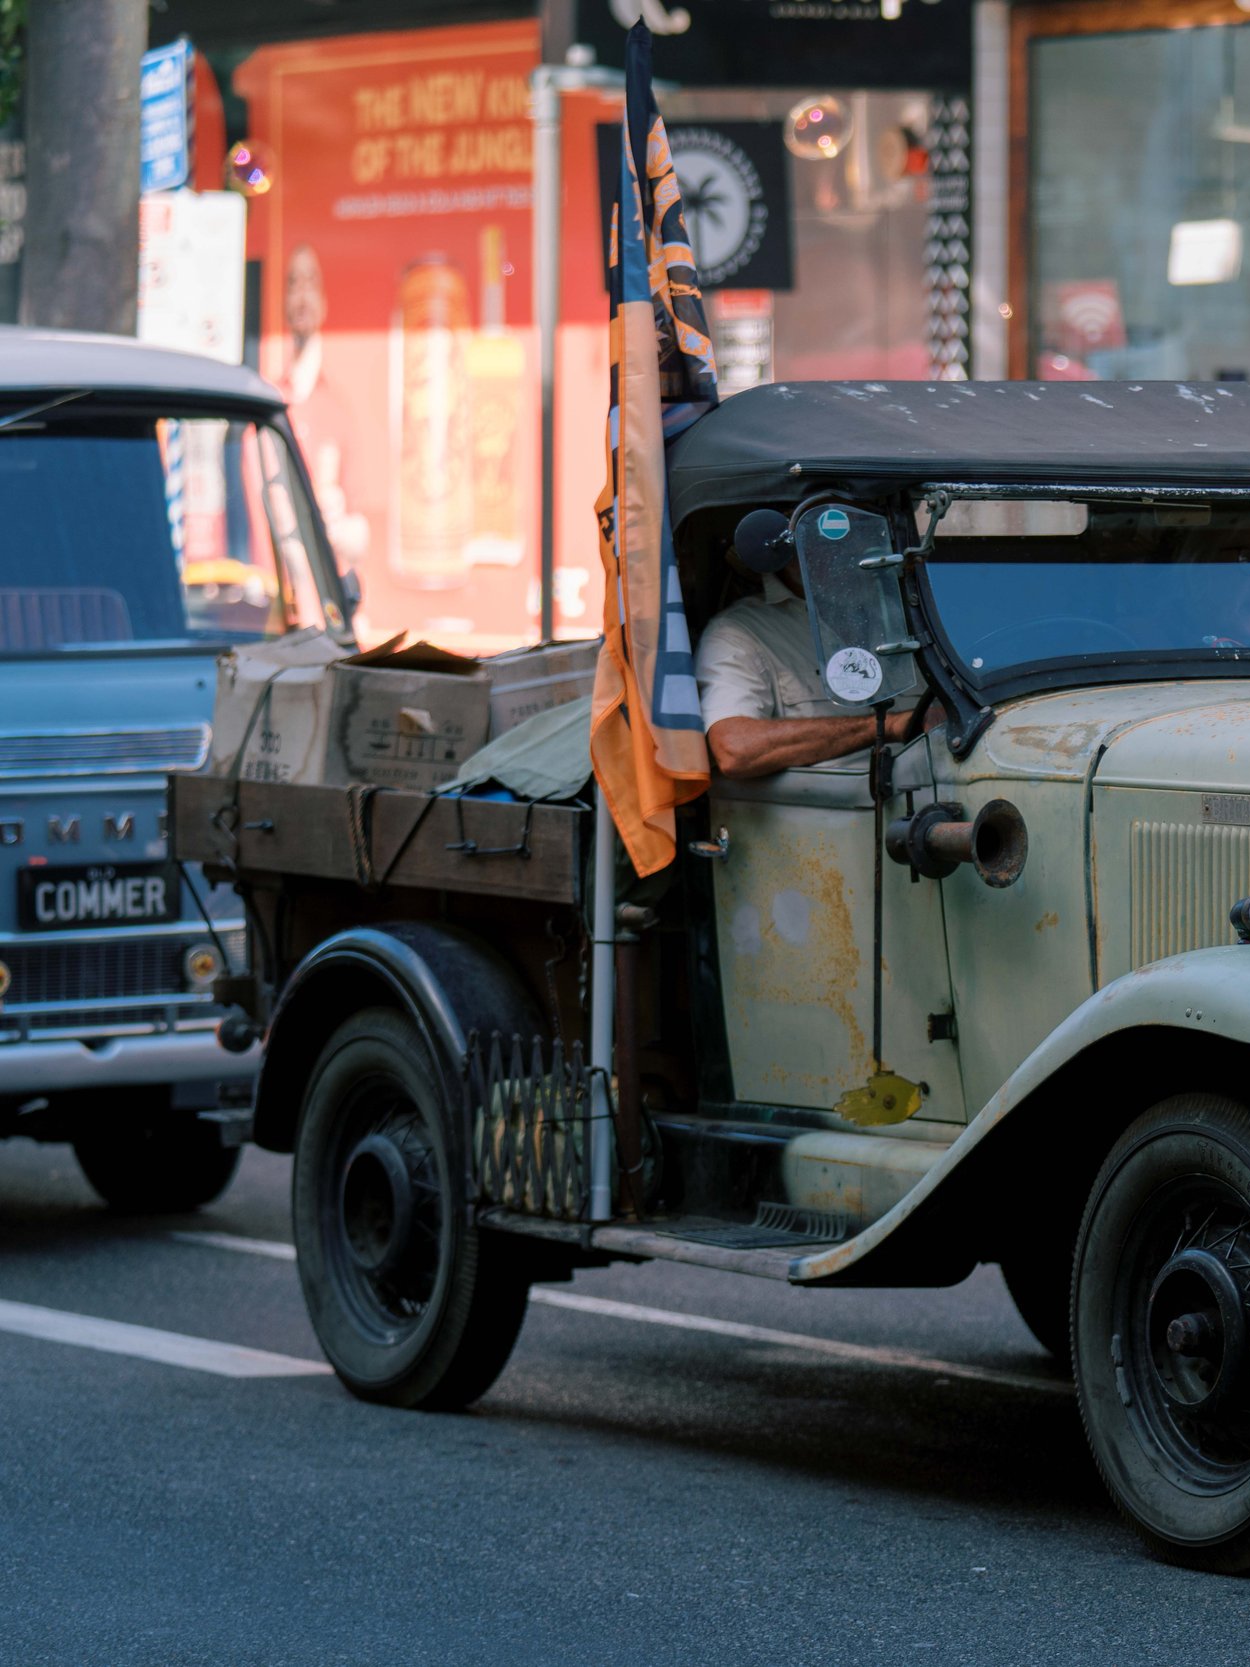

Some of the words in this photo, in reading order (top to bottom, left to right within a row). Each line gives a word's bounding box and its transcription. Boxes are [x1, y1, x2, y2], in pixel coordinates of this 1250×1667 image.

[408, 68, 484, 125] NEW
[451, 124, 533, 174] JUNGL
[35, 876, 166, 922] COMMER
